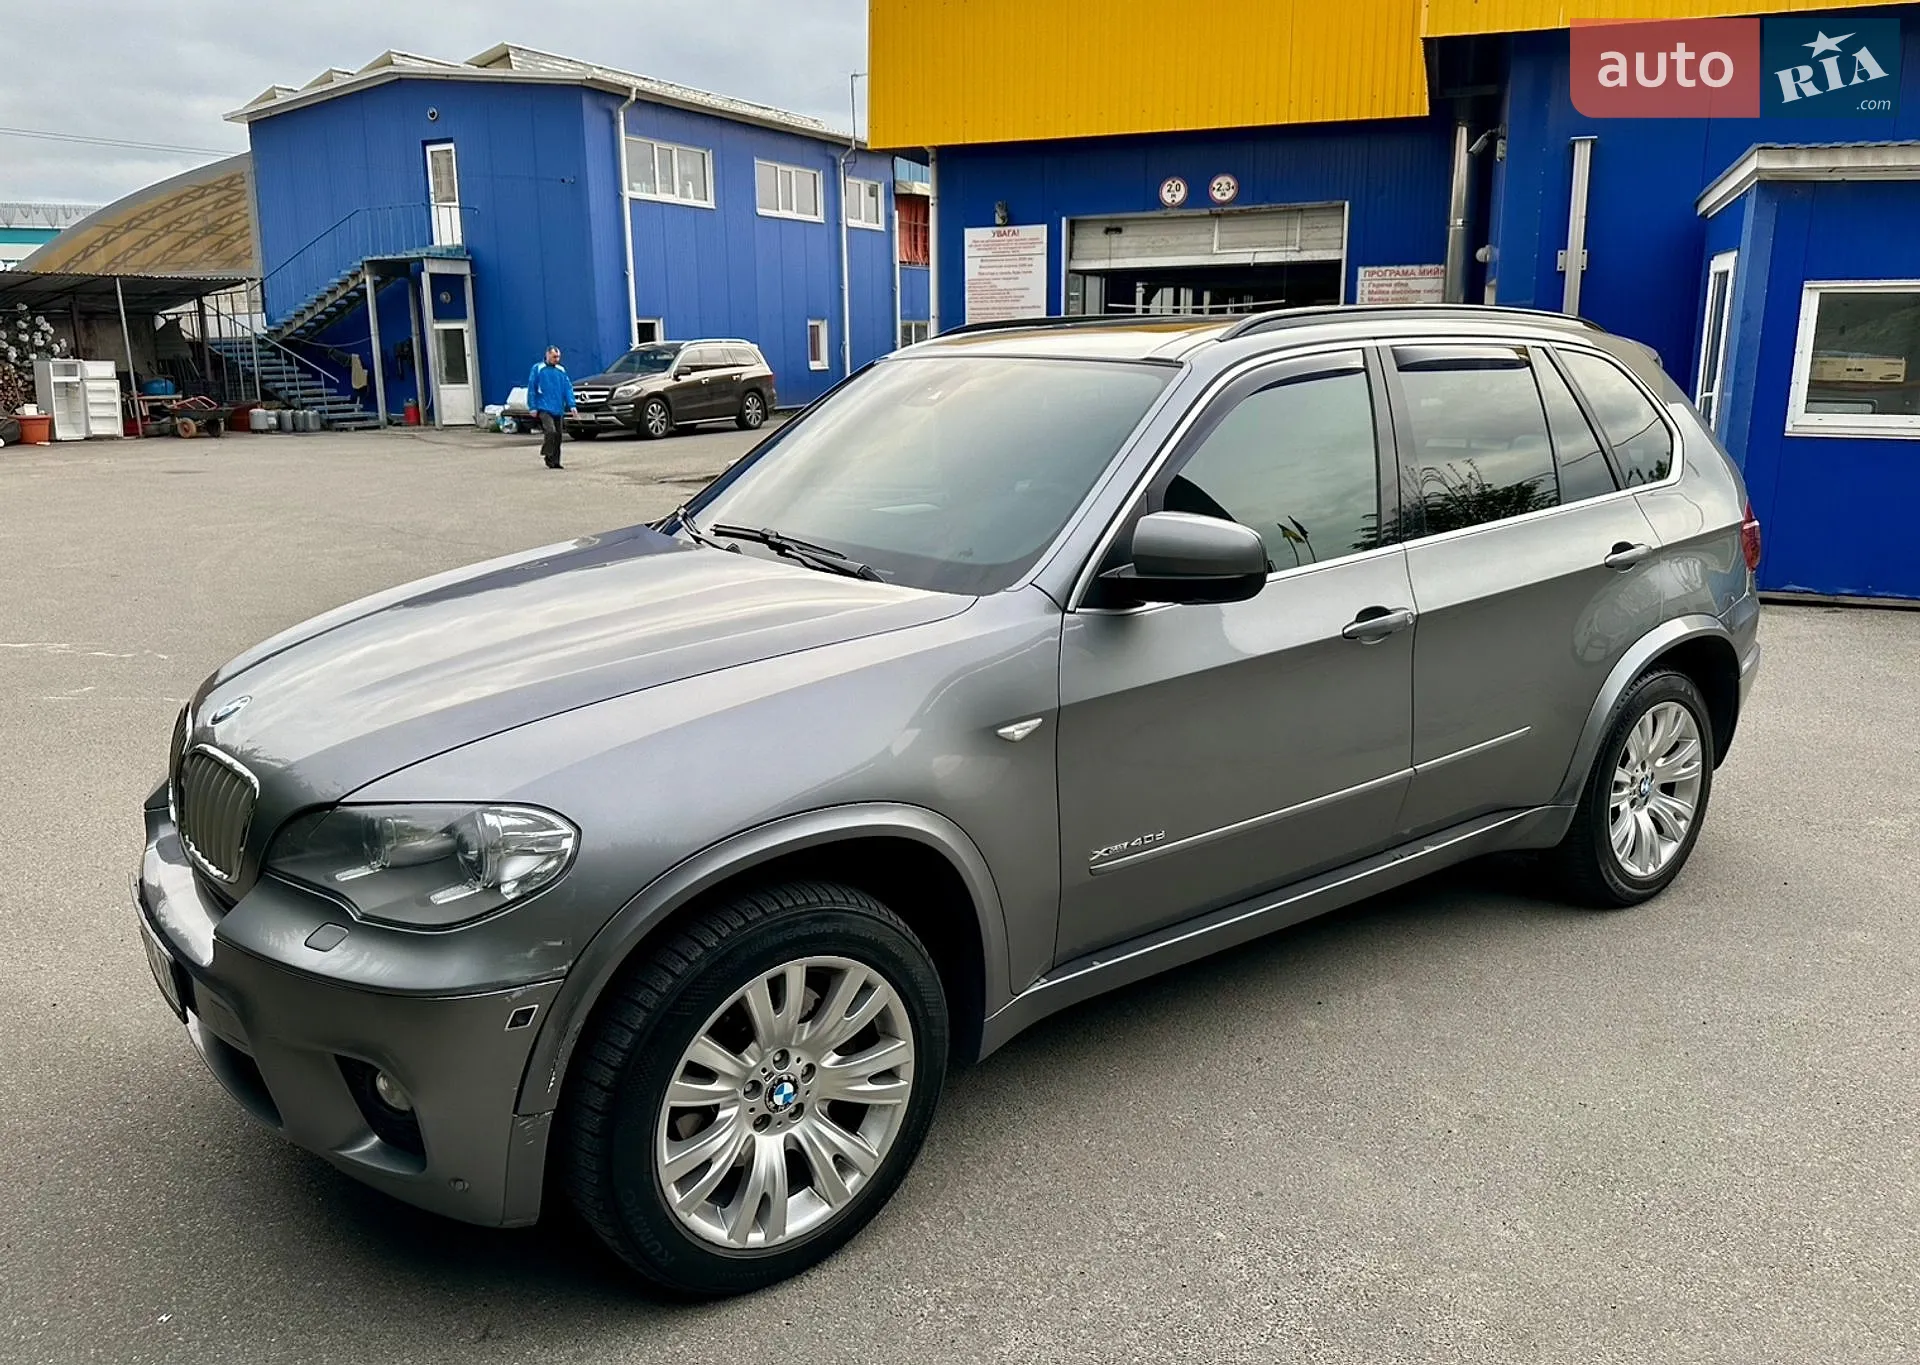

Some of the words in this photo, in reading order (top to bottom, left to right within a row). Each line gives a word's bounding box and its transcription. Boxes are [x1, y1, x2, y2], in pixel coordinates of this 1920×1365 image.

[991, 229, 1020, 238] УВАГА!
[1364, 268, 1416, 278] ПРОГРАМА
[620, 1188, 677, 1267] KUMHO
